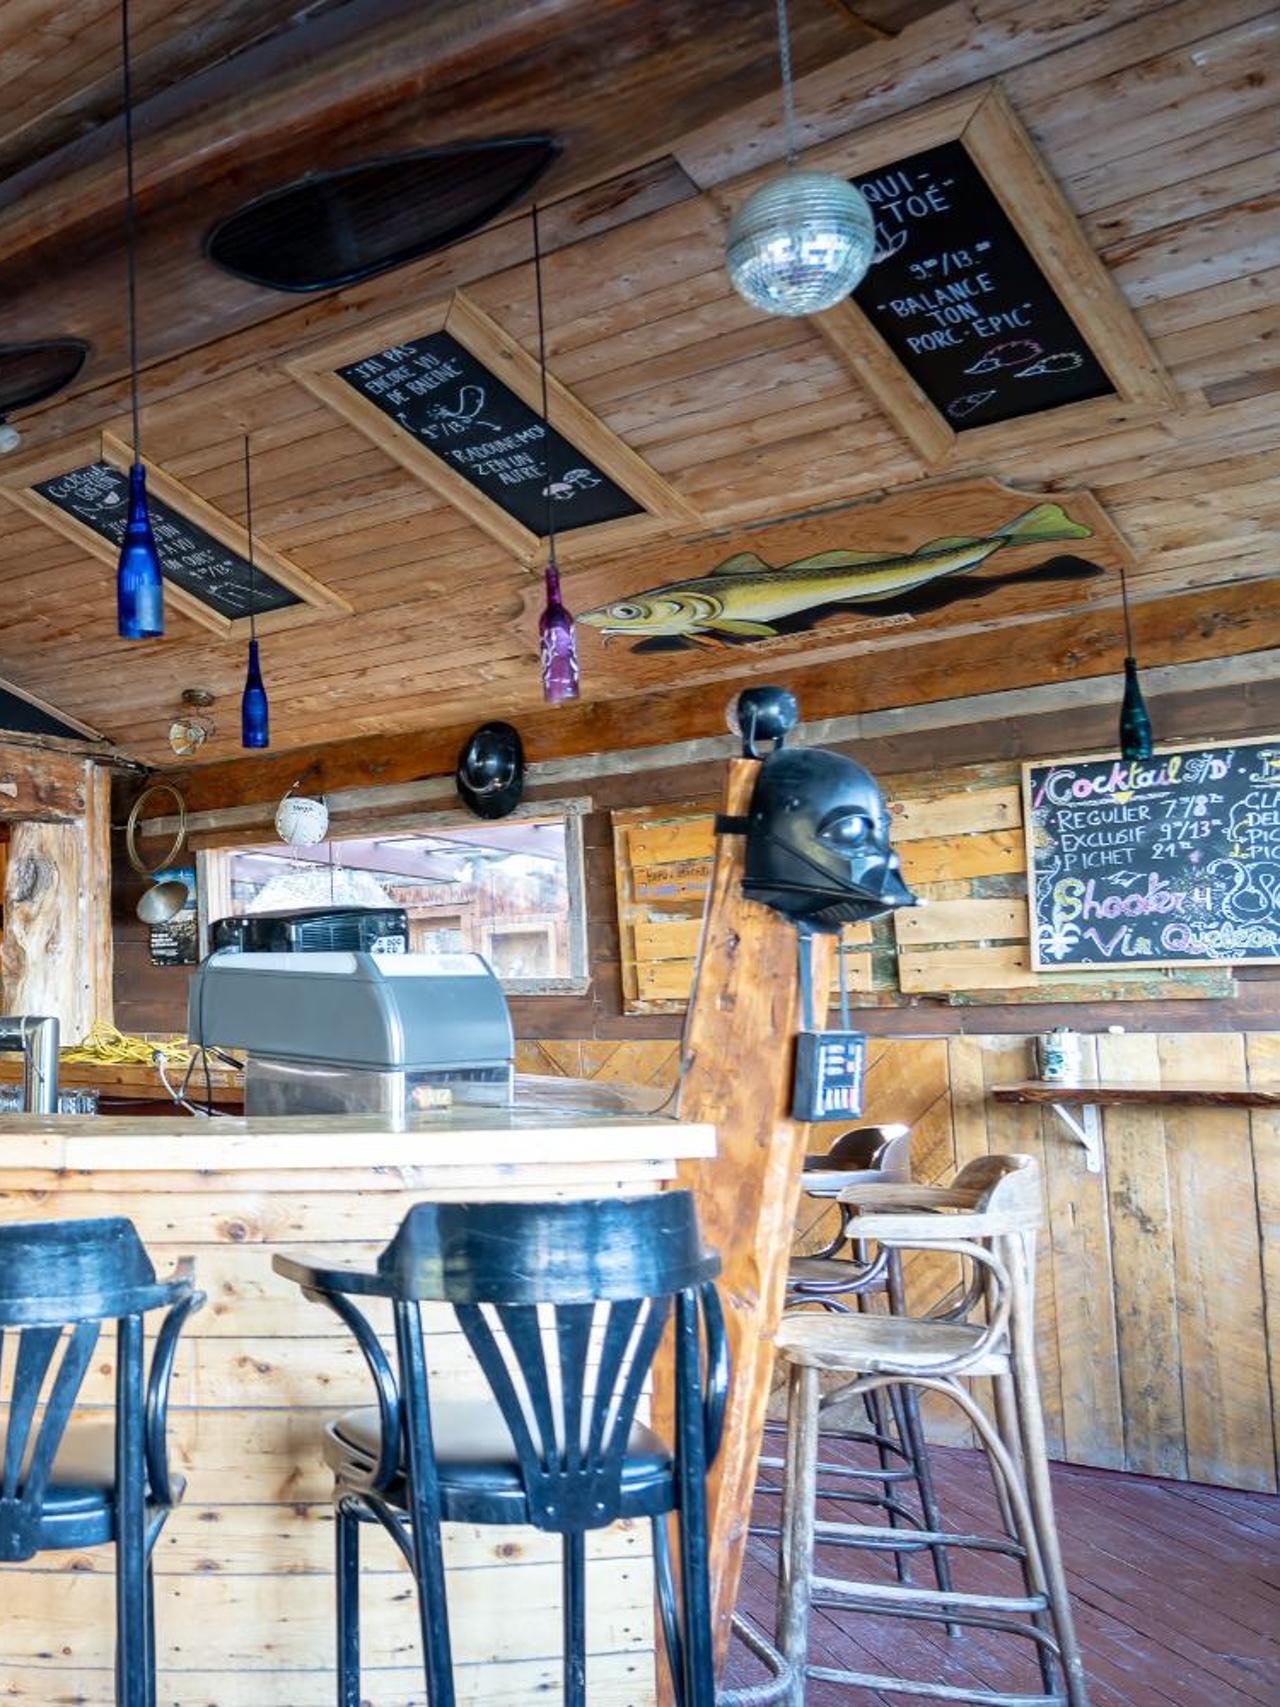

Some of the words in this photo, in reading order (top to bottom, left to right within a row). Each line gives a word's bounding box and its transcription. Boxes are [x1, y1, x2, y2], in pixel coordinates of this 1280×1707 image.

[924, 301, 980, 327] TON
[382, 344, 417, 362] PAS
[364, 365, 416, 395] ENCORE
[386, 389, 410, 406] DE
[1045, 756, 1181, 804] Cocktail
[1061, 826, 1146, 851] EXCLUSIF
[1062, 848, 1136, 871] PICHET
